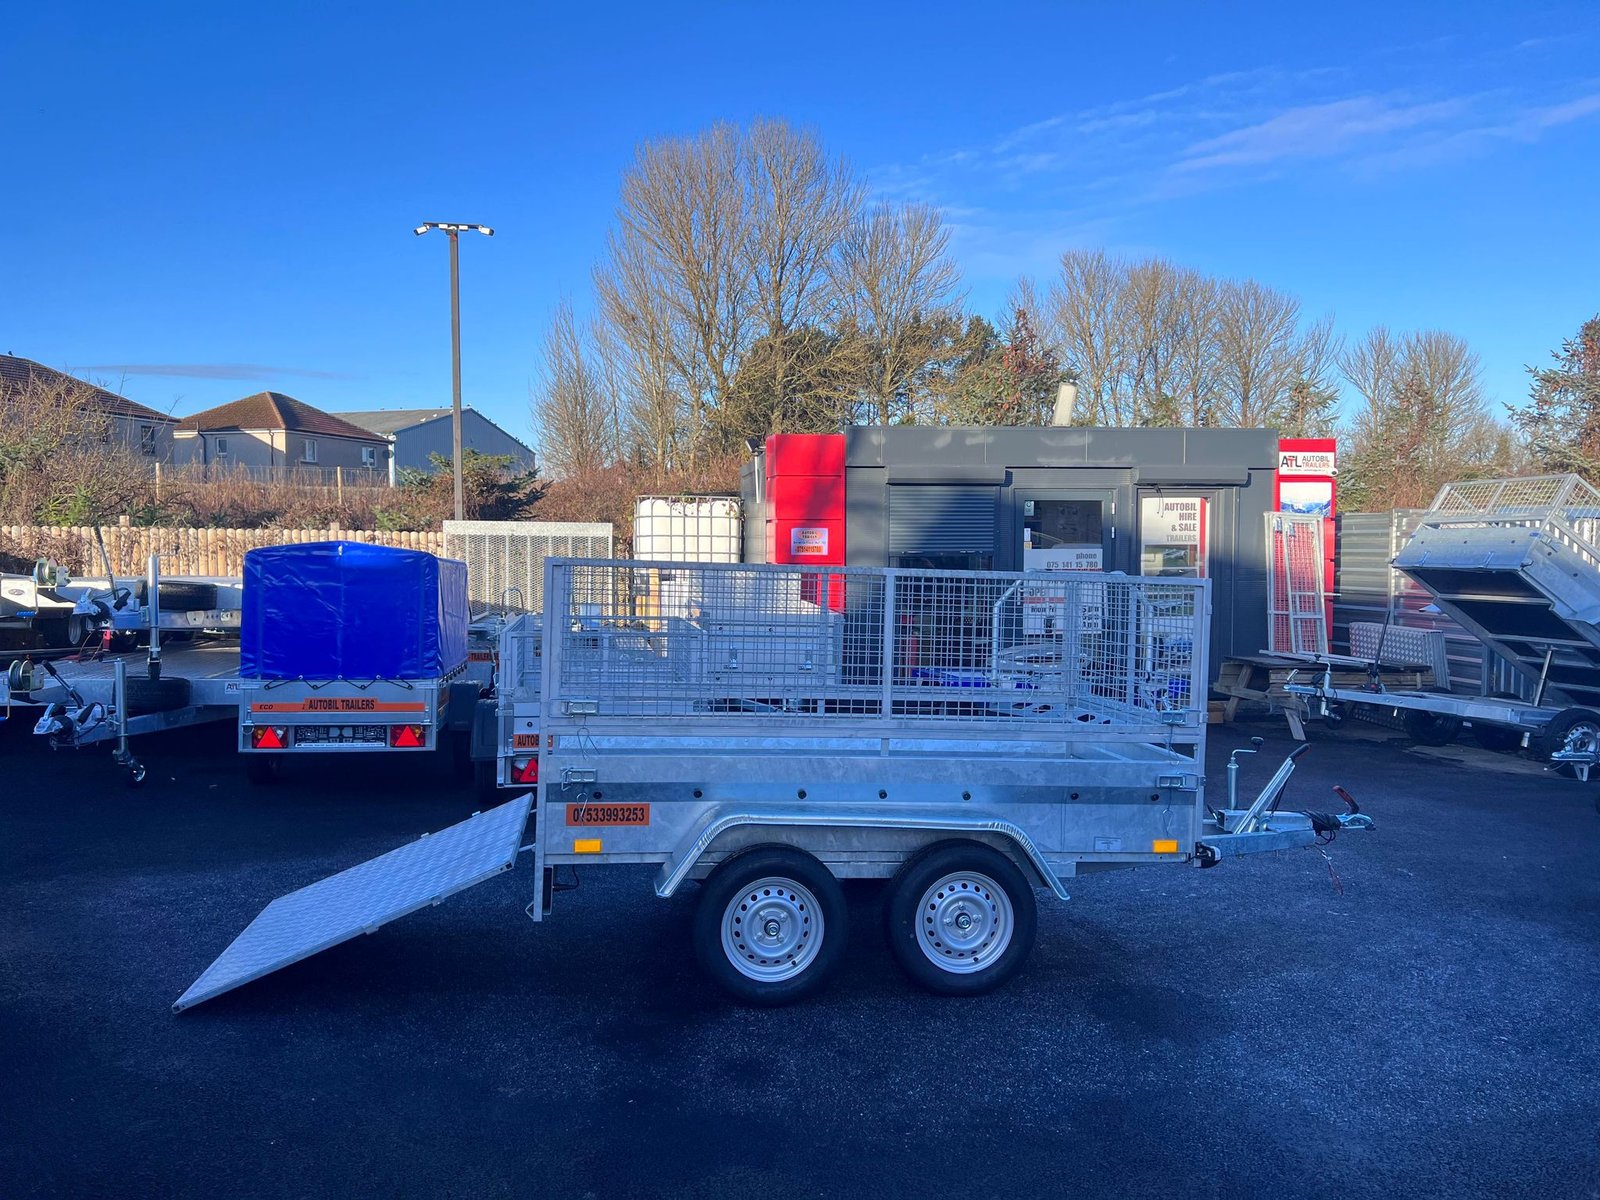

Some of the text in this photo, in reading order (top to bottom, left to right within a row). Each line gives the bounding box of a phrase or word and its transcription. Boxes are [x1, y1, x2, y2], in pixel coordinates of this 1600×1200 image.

[1281, 455, 1302, 468] ATL
[1164, 502, 1197, 511] AUTOBIL
[1178, 512, 1197, 521] HIRE
[1171, 523, 1197, 532] & SALE
[1166, 534, 1196, 542] TRAILERS
[1075, 552, 1097, 560] phone
[1046, 561, 1059, 569] 075
[308, 699, 339, 710] AUTOBIL
[341, 699, 375, 710] TRAILERS
[517, 735, 539, 746] AUTOB
[573, 807, 645, 822] 07533993253
